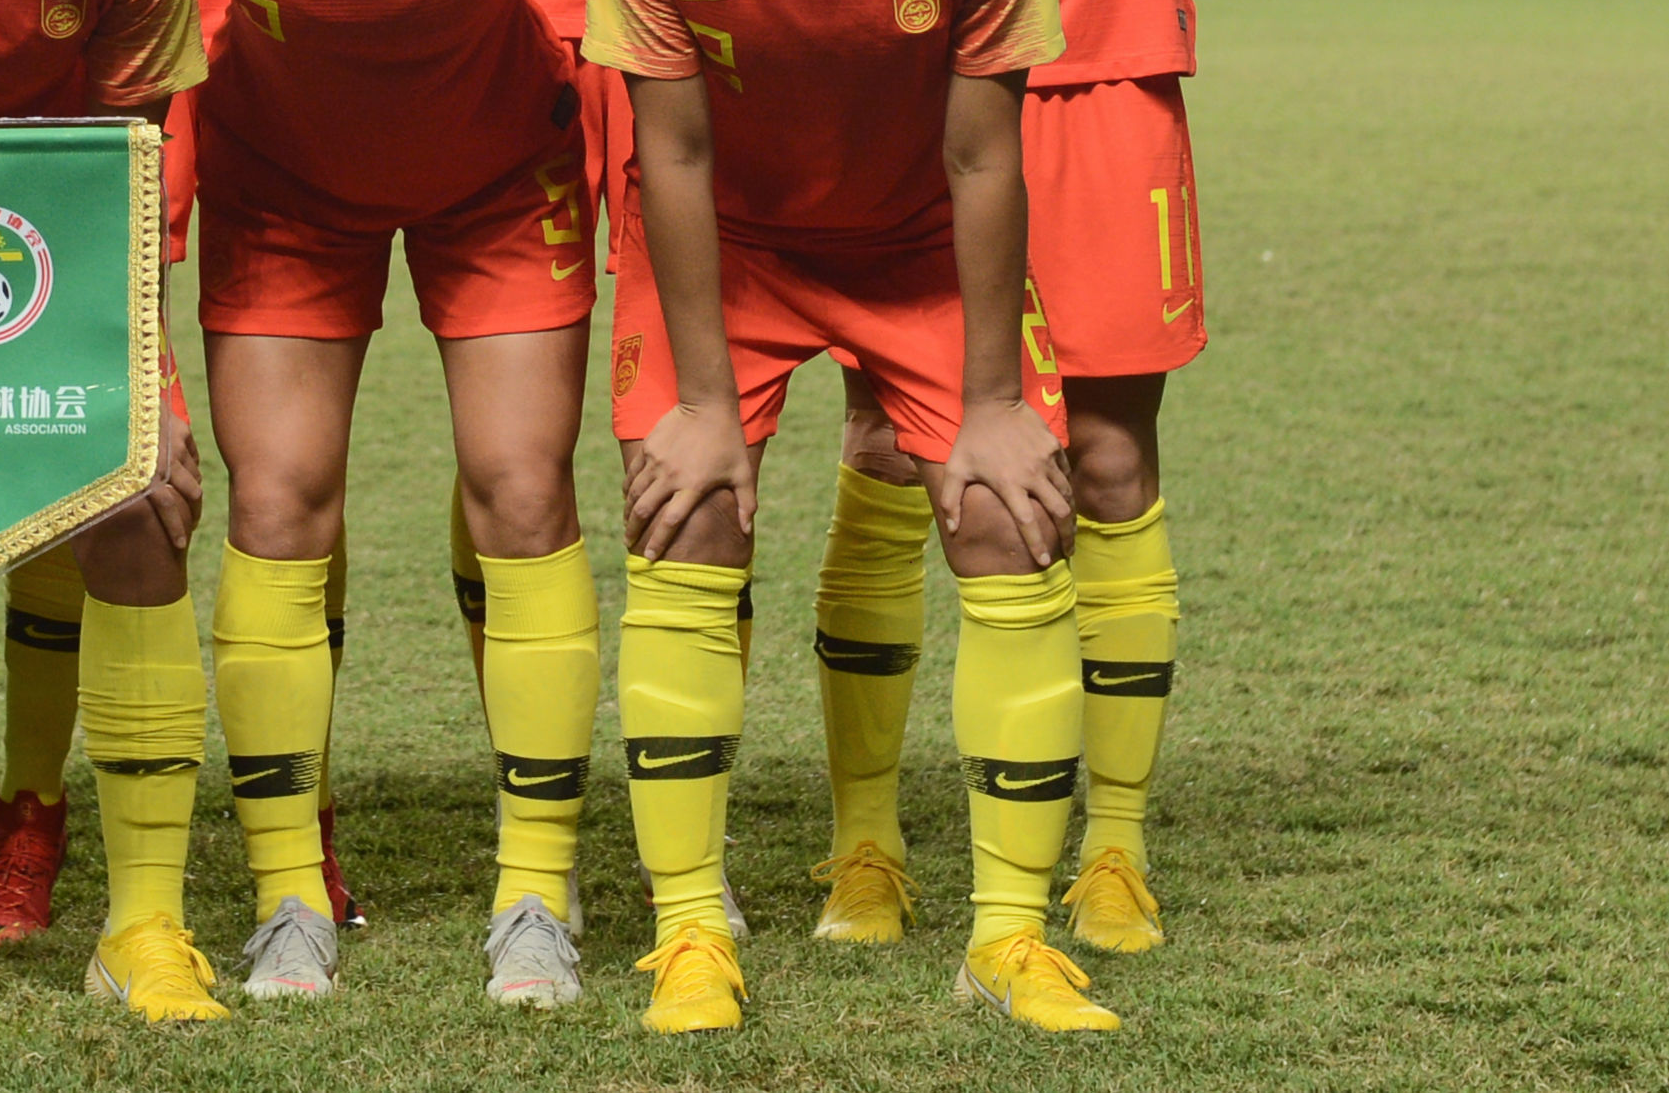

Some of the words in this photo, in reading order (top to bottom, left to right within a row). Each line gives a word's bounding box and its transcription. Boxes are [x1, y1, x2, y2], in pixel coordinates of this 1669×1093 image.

[534, 151, 581, 246] 5
[1150, 185, 1195, 291] 11
[5, 423, 87, 435] ASSOCIATION
